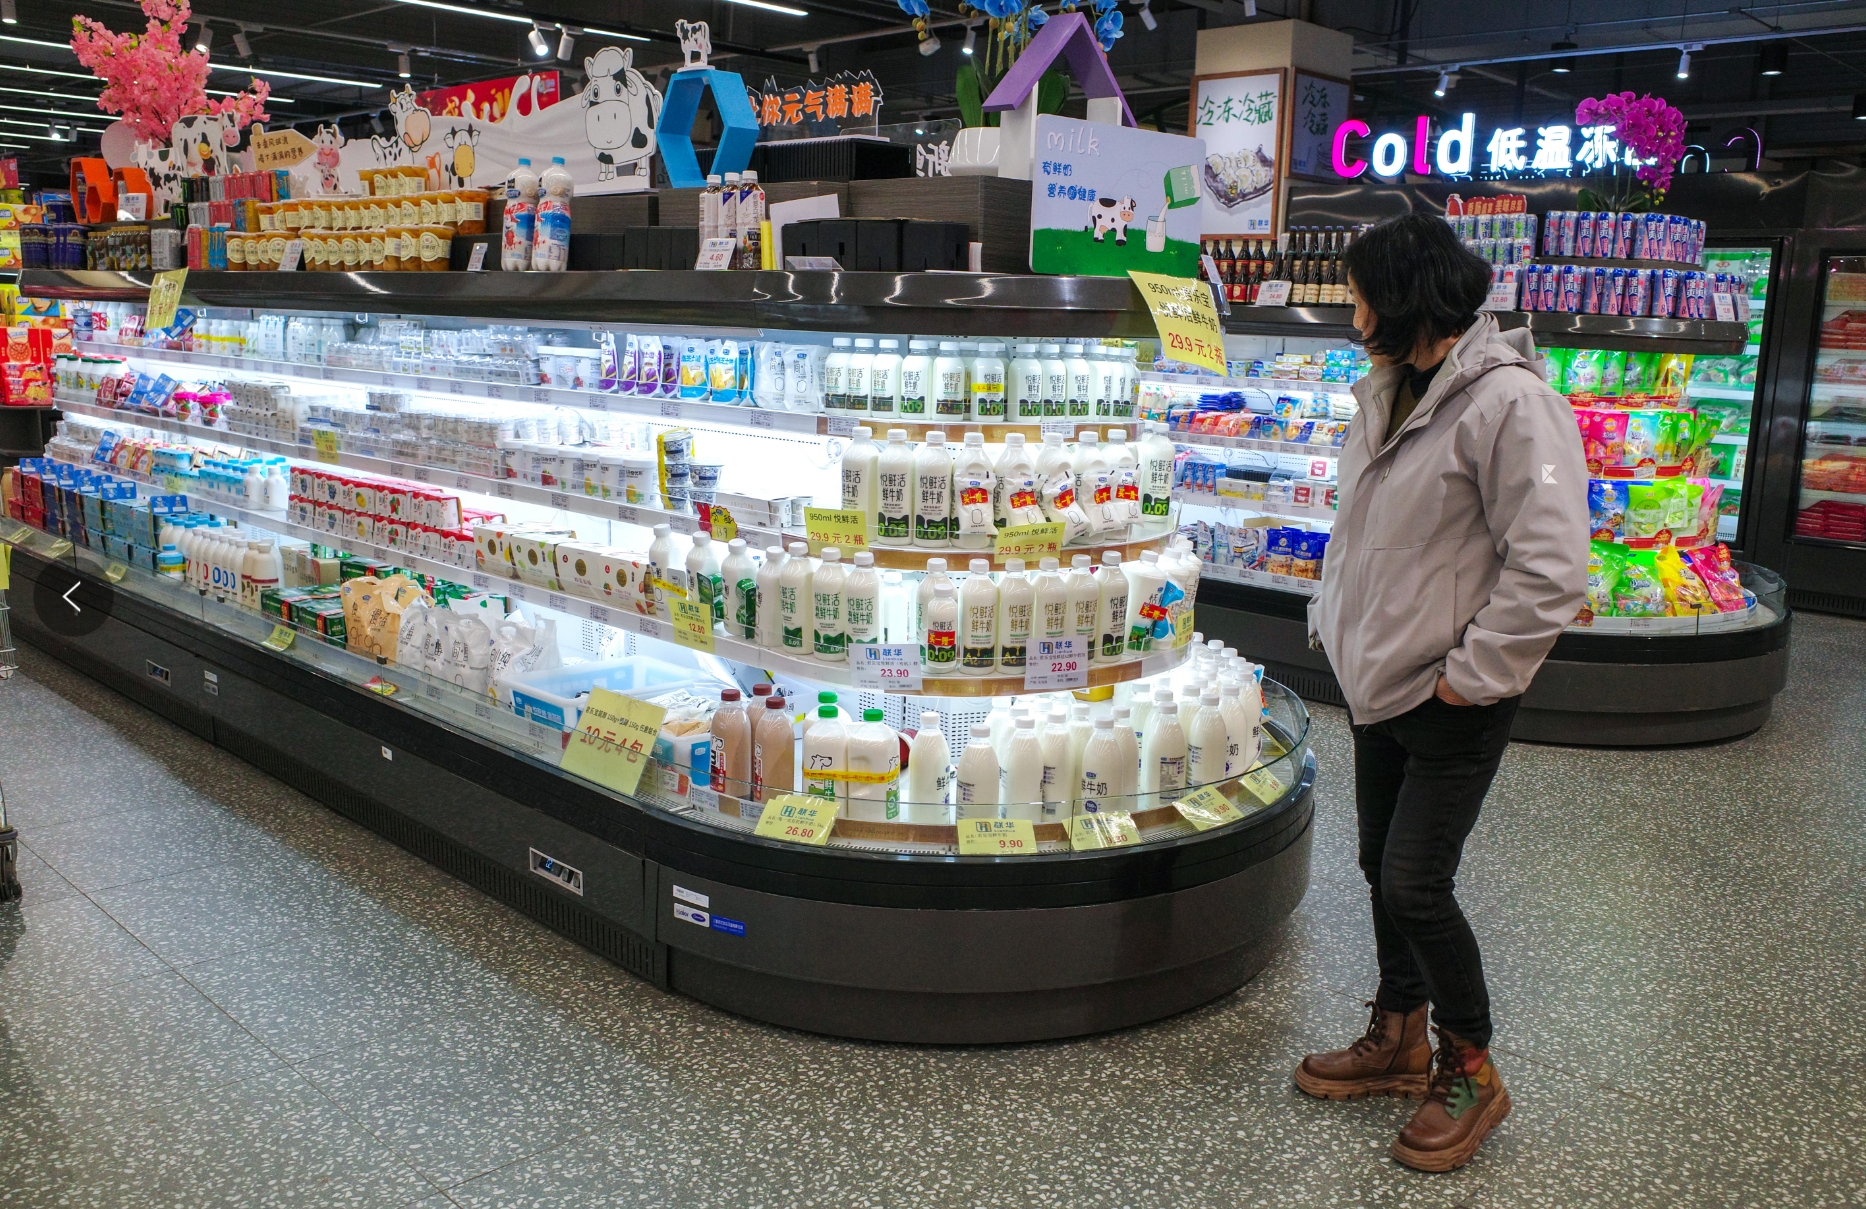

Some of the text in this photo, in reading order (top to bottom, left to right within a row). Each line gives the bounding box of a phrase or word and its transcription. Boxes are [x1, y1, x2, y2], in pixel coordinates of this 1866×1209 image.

[1302, 80, 1330, 108] 冷冻
[1196, 90, 1277, 126] 冷冻冷藏
[1047, 127, 1100, 156] milk
[1332, 112, 1475, 178] Cold
[1487, 124, 1657, 173] 低温冻
[1168, 332, 1225, 367] 29.9 元 2 瓶
[1150, 459, 1172, 473] 悦鲜活
[880, 472, 906, 488] 悦鲜活
[920, 475, 947, 490] 悦鲜活
[882, 488, 903, 502] 鲜牛奶
[922, 490, 943, 504] 鲜牛奶
[1143, 502, 1169, 515] 0.09
[809, 513, 858, 524] 950ml 悦鲜活
[810, 532, 865, 546] 29.9 元 2 瓶
[1004, 527, 1058, 539] 950ml 悦鲜活
[998, 542, 1058, 556] 29.9 元 2 瓶
[780, 587, 797, 601] 鲜活
[814, 591, 840, 606] 悦鲜活
[847, 597, 874, 611] 悦鲜活
[969, 604, 995, 618] 悦鲜活
[1009, 603, 1033, 617] 悦鲜活
[1044, 602, 1067, 616] 悦鲜活
[971, 618, 992, 632] 鲜牛奶
[1011, 618, 1029, 632] 鲜牛奶
[1055, 640, 1073, 650] 联华
[882, 648, 903, 657] 联华
[880, 668, 909, 678] 23.90
[1051, 661, 1077, 672] 22.90
[580, 725, 644, 763] 10 元 4 包
[797, 807, 818, 817] 联华
[1214, 804, 1231, 815] 9.90
[994, 821, 1015, 829] 联华
[785, 826, 814, 839] 26.80
[999, 840, 1023, 849] 9.90
